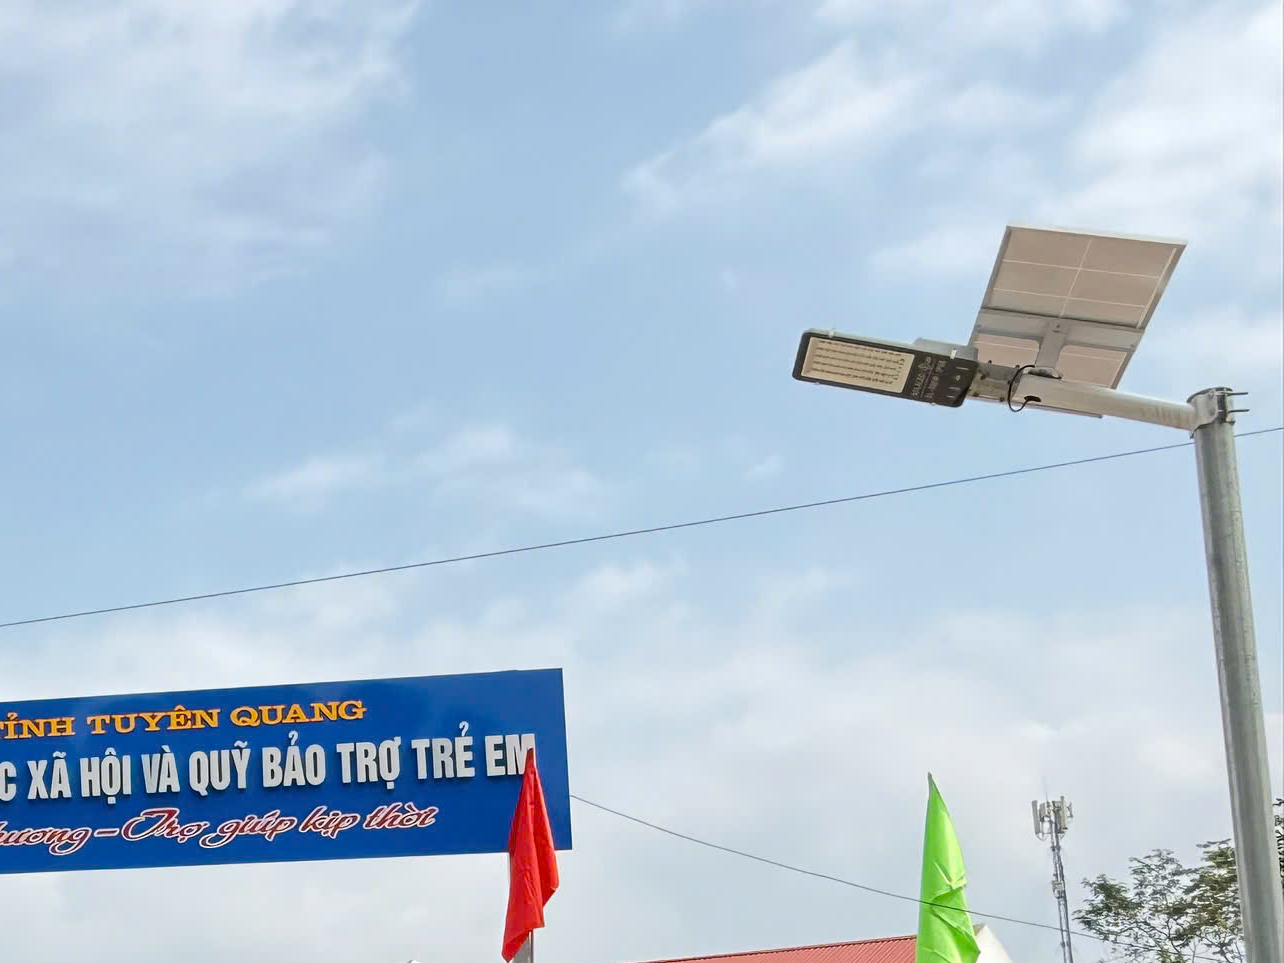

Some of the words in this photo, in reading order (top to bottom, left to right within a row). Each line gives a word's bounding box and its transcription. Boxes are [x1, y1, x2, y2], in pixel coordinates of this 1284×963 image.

[86, 704, 220, 735] TUYÊN
[230, 700, 367, 727] QUANG
[27, 750, 72, 800] XÃ
[80, 747, 132, 805] HỘI
[141, 745, 181, 794] VÀ
[189, 740, 252, 797] QUỸ
[262, 730, 327, 788] BẢO
[336, 736, 402, 790] TRỢ
[411, 720, 476, 780] TRẺ
[484, 733, 536, 777] EM
[121, 807, 210, 843] Trợ
[199, 809, 297, 848] giúp
[298, 805, 361, 839] kịp
[363, 801, 439, 830] thời
